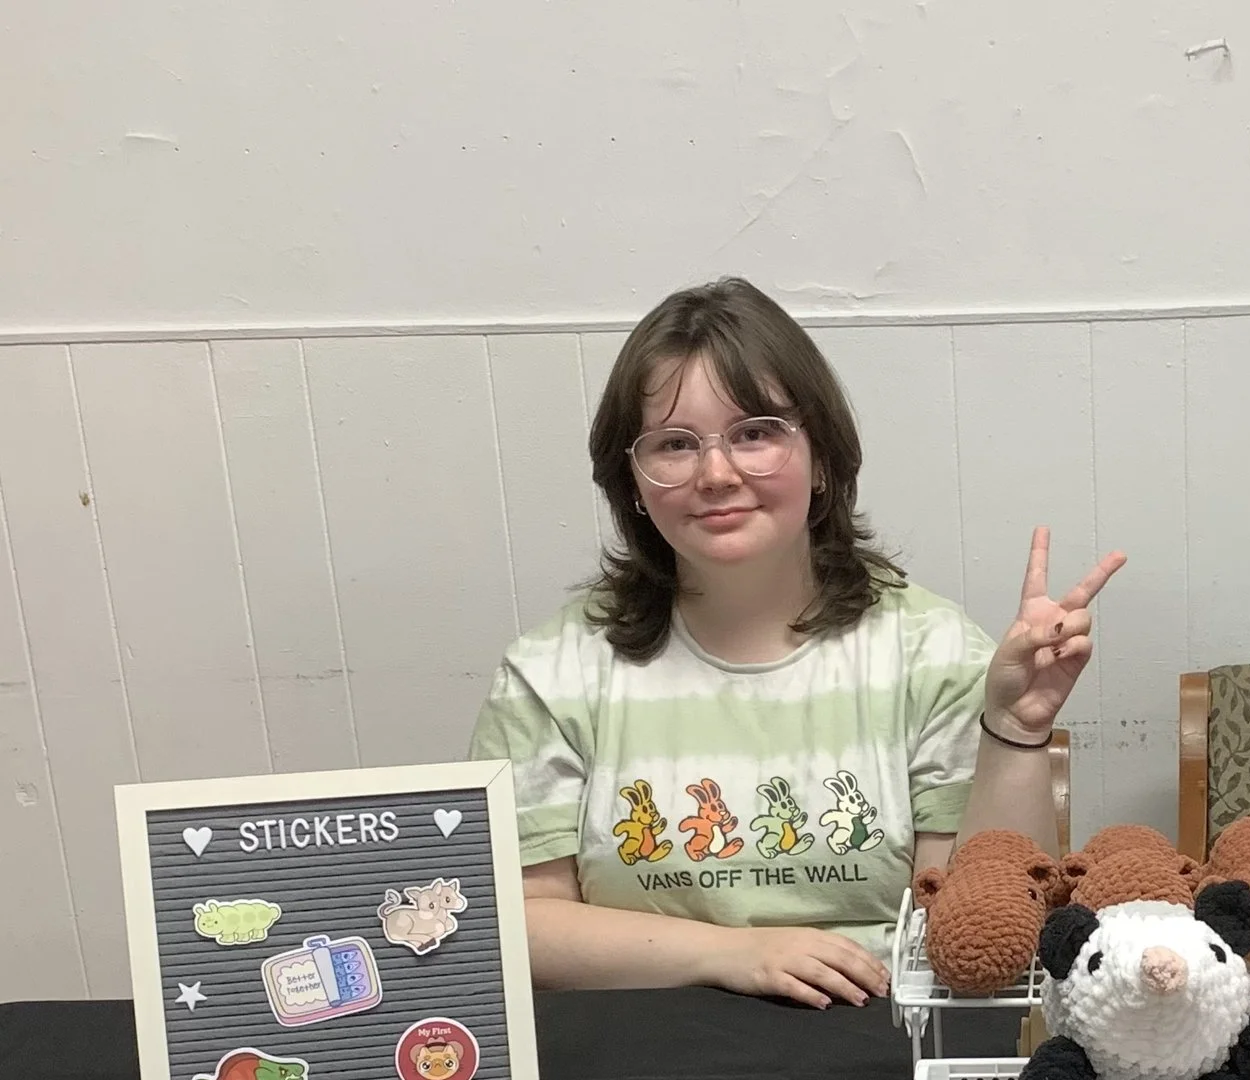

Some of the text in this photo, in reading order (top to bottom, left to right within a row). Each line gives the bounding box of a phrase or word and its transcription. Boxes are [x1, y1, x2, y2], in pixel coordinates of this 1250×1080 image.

[239, 811, 399, 852] STICKERS
[637, 864, 868, 891] VANS OFF THE WALL
[286, 972, 315, 985] Better
[418, 1027, 452, 1037] My First
